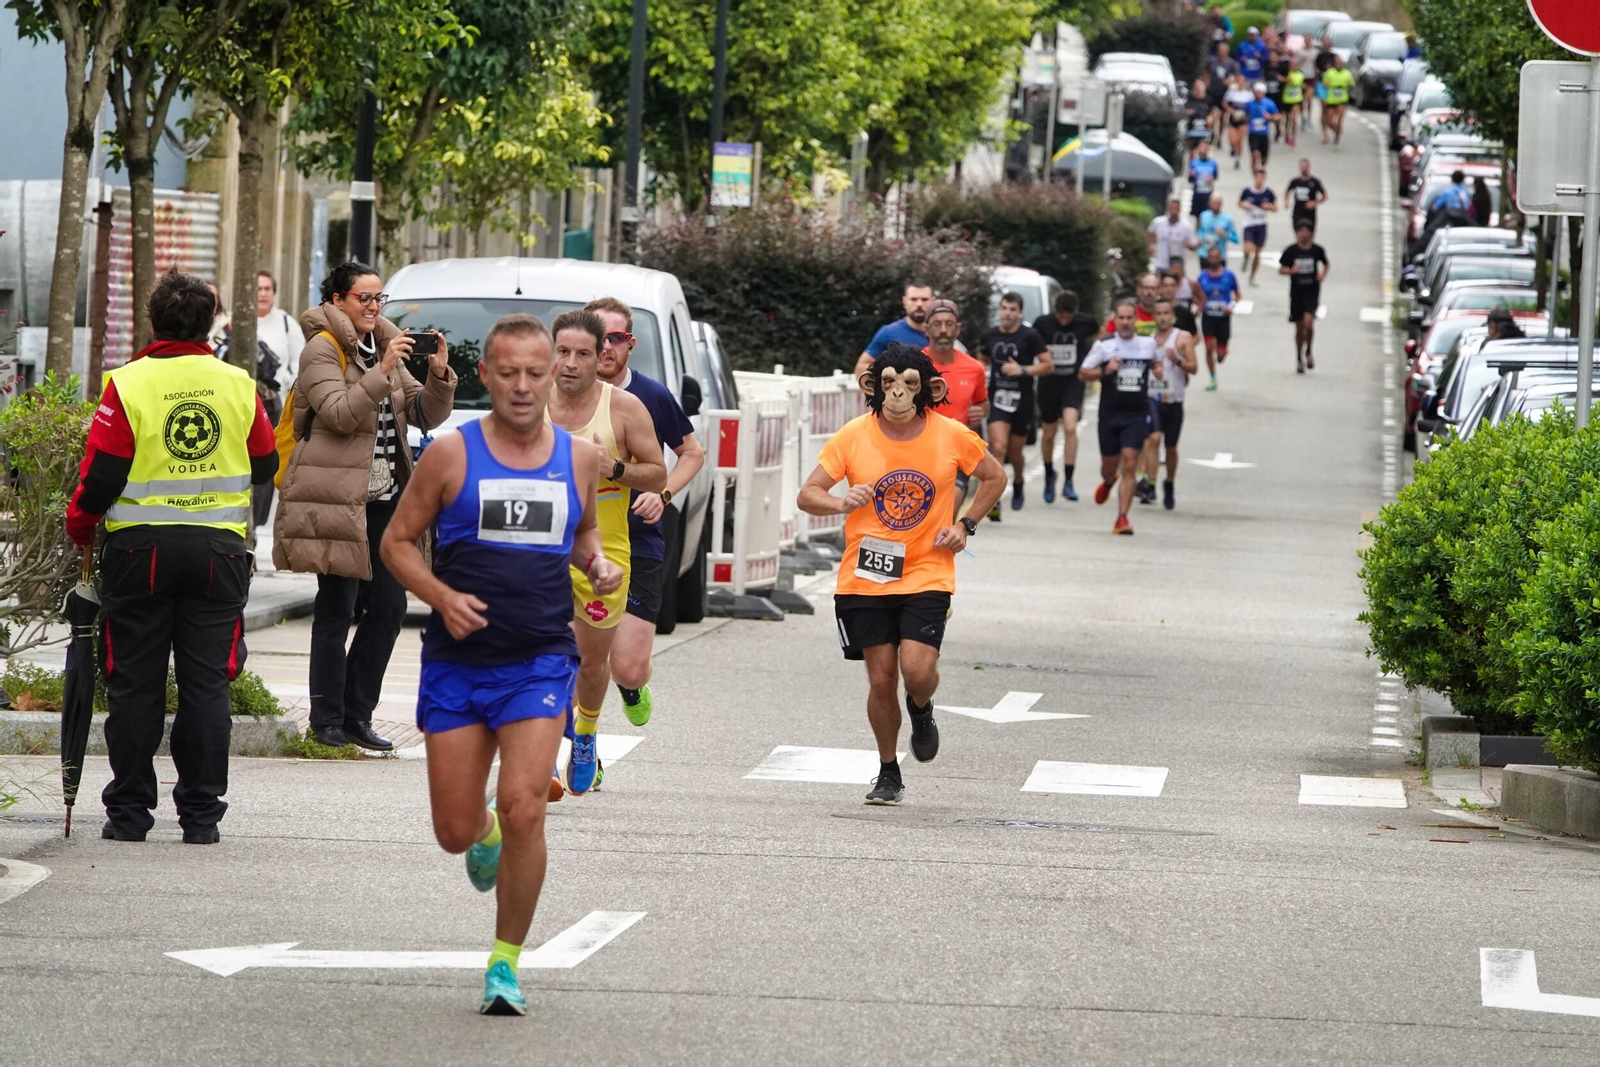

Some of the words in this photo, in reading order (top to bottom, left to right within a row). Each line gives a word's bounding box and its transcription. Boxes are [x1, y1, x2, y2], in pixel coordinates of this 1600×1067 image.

[164, 388, 214, 401] ASOCIACIÓN
[172, 404, 208, 417] VOLUNTARIOS
[191, 432, 218, 458] ACTIVIDADES
[168, 463, 216, 474] VODEA
[878, 473, 932, 492] AROUSAMAN
[176, 496, 208, 506] Recalvi
[504, 500, 528, 524] 19
[904, 508, 926, 526] GALICIA
[864, 550, 894, 572] 255
